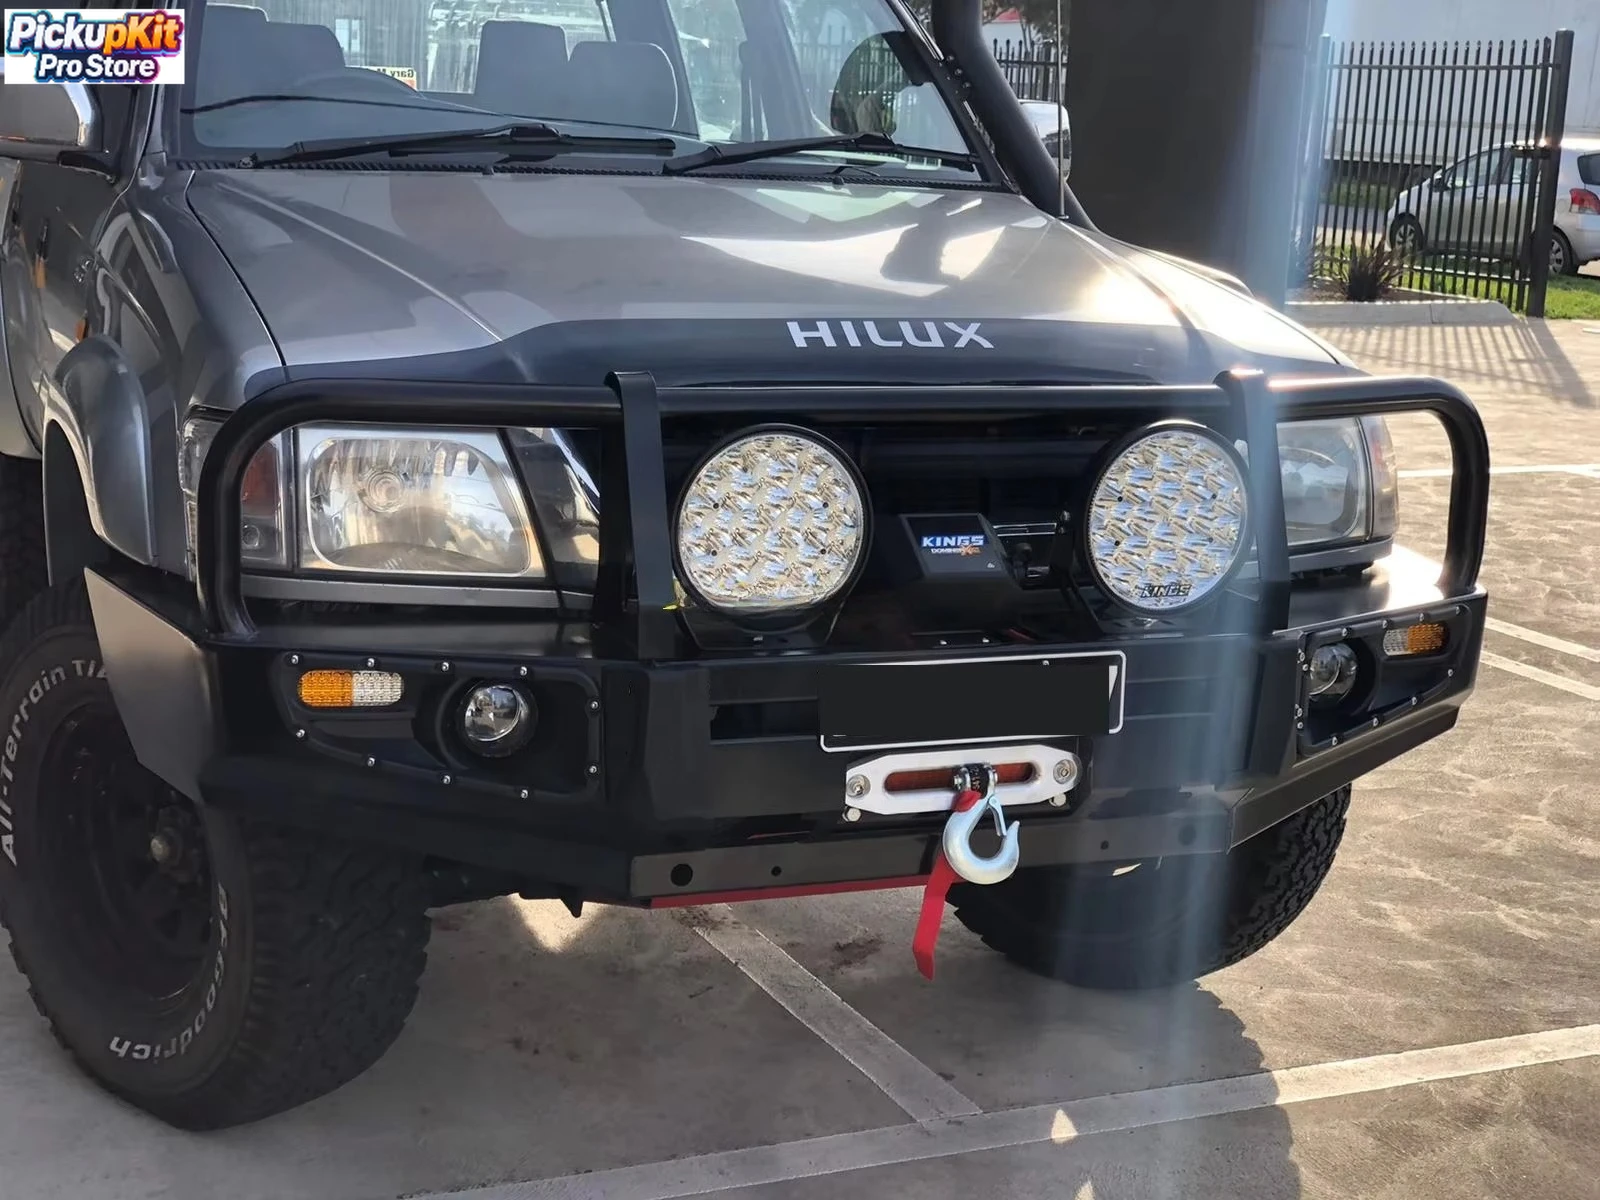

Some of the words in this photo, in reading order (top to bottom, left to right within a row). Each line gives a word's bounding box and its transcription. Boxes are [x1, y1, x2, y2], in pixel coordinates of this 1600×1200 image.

[786, 320, 995, 349] HILUX
[922, 535, 984, 547] KINGS
[1140, 583, 1192, 598] KINGS
